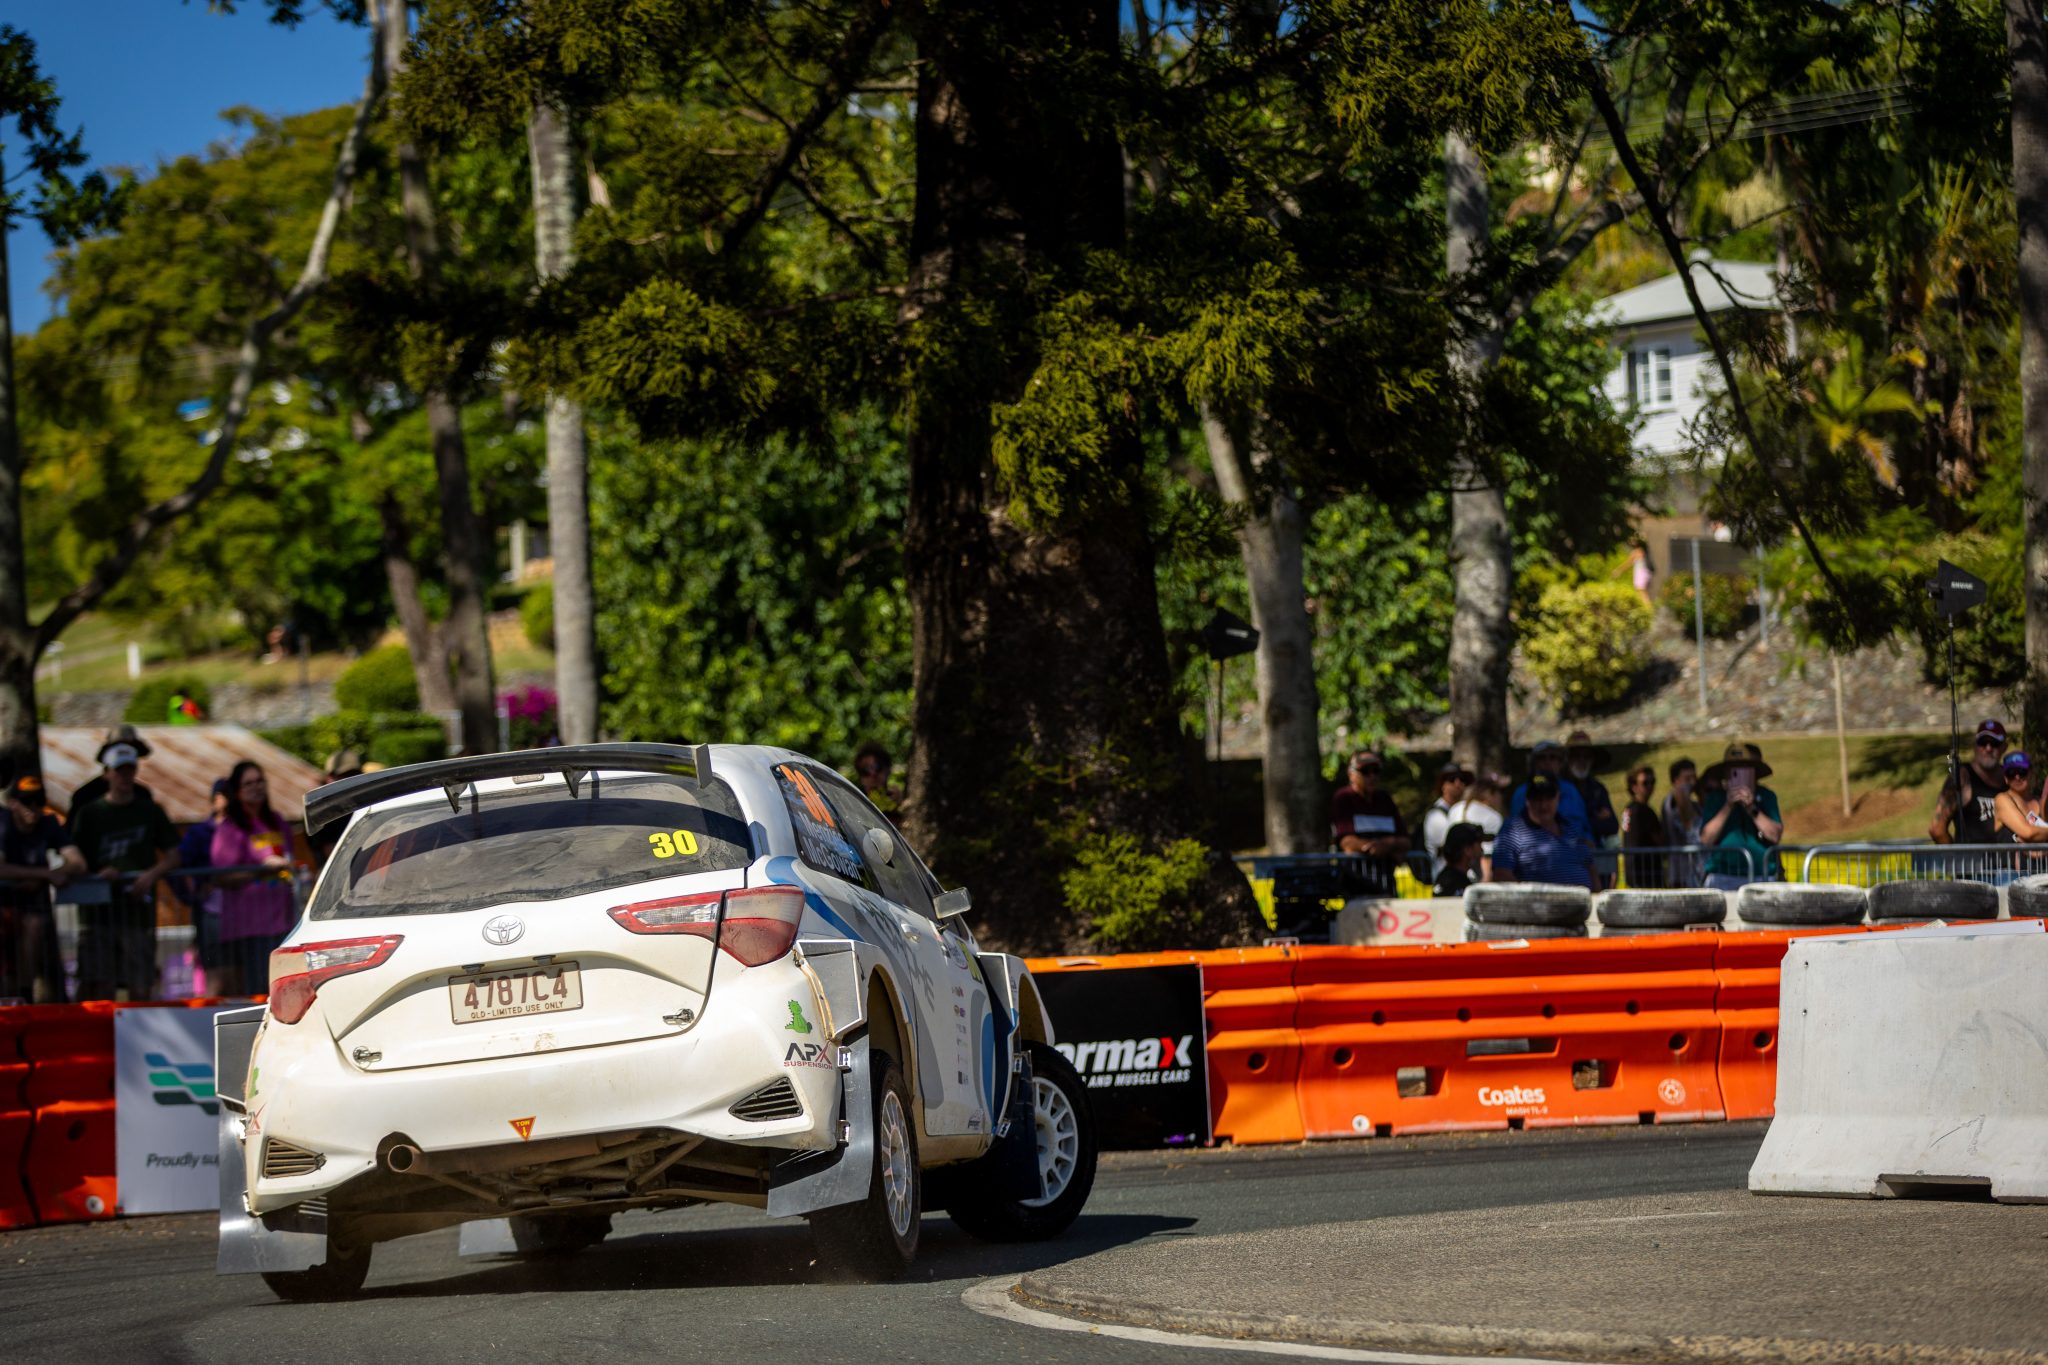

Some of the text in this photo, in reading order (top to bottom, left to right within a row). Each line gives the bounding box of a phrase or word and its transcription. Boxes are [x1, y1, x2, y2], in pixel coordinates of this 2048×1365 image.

[779, 764, 835, 828] 30
[648, 829, 699, 859] 30
[1376, 911, 1434, 940] 02
[464, 967, 568, 1010] 4787C4
[525, 1003, 541, 1012] USE
[544, 1001, 564, 1010] ONLY
[784, 1040, 832, 1065] APX
[783, 1060, 833, 1070] SUSPENSION
[1087, 1074, 1113, 1088] AND
[1114, 1071, 1160, 1087] MUSCLE
[1160, 1068, 1191, 1084] CARS
[1478, 1085, 1546, 1106] Coates
[145, 1152, 200, 1170] Proudly
